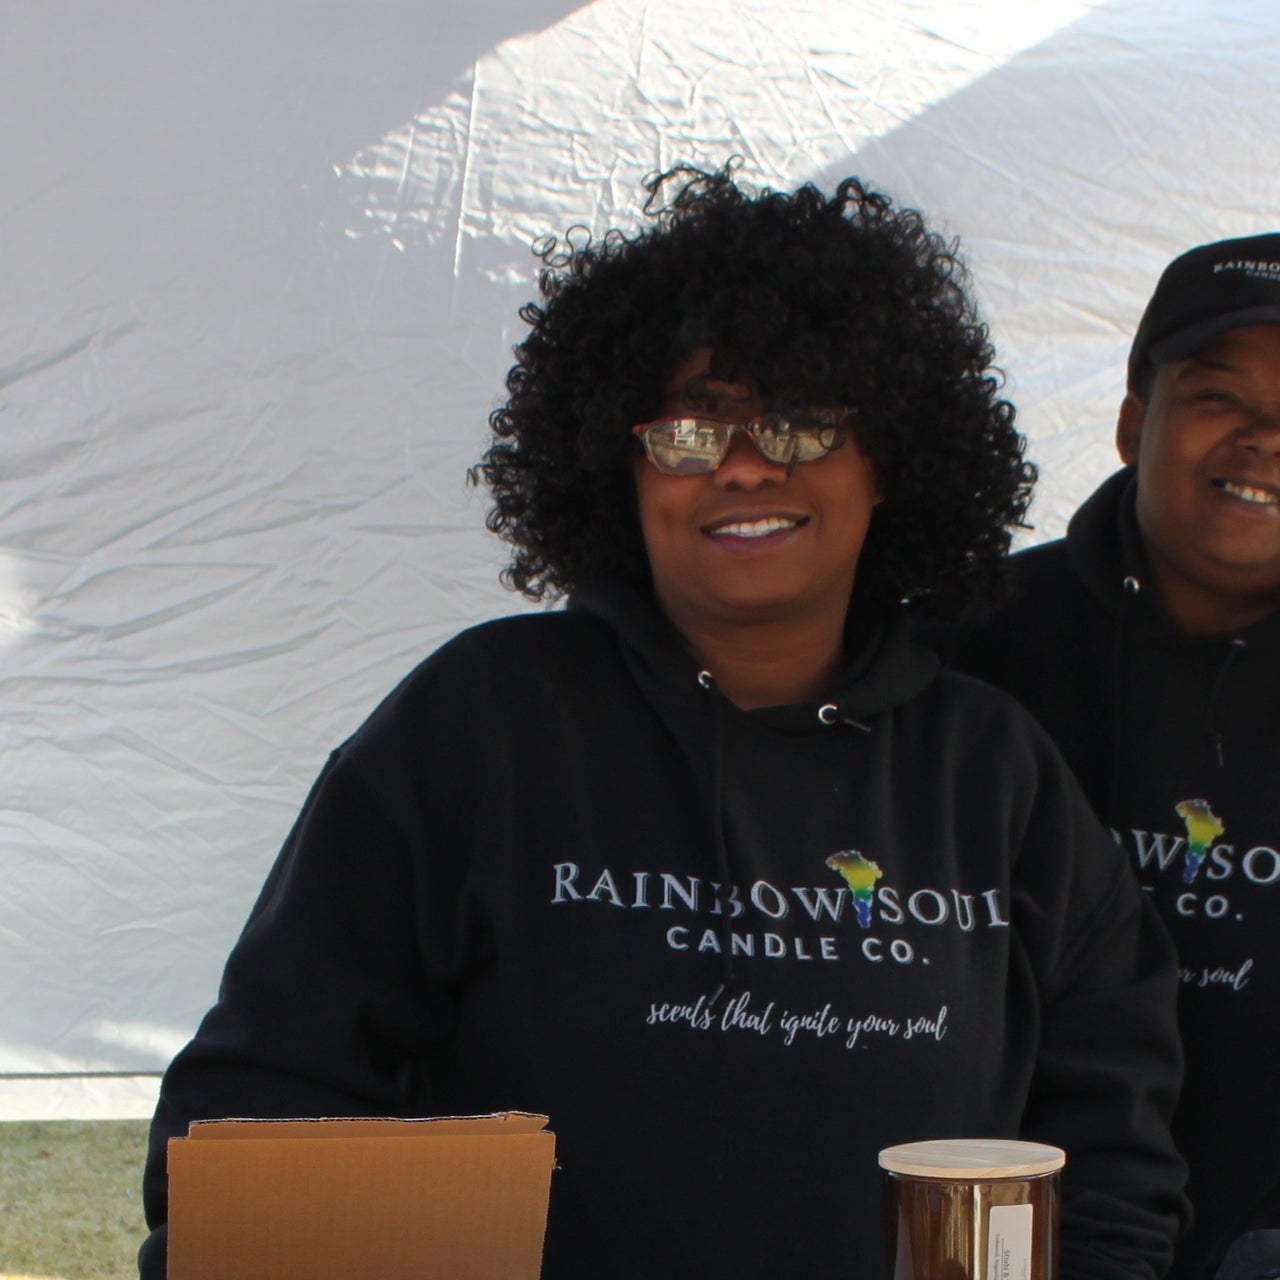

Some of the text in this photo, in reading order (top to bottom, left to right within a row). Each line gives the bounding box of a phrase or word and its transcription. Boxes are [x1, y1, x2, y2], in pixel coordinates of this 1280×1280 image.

[551, 862, 1010, 931] RAINBOW SOUL
[1177, 892, 1243, 921] CO.
[666, 926, 930, 965] CANDLE CO.
[1198, 959, 1254, 991] soul
[646, 990, 948, 1049] scents that ignite your soul
[1002, 1250, 1011, 1272] Studs
